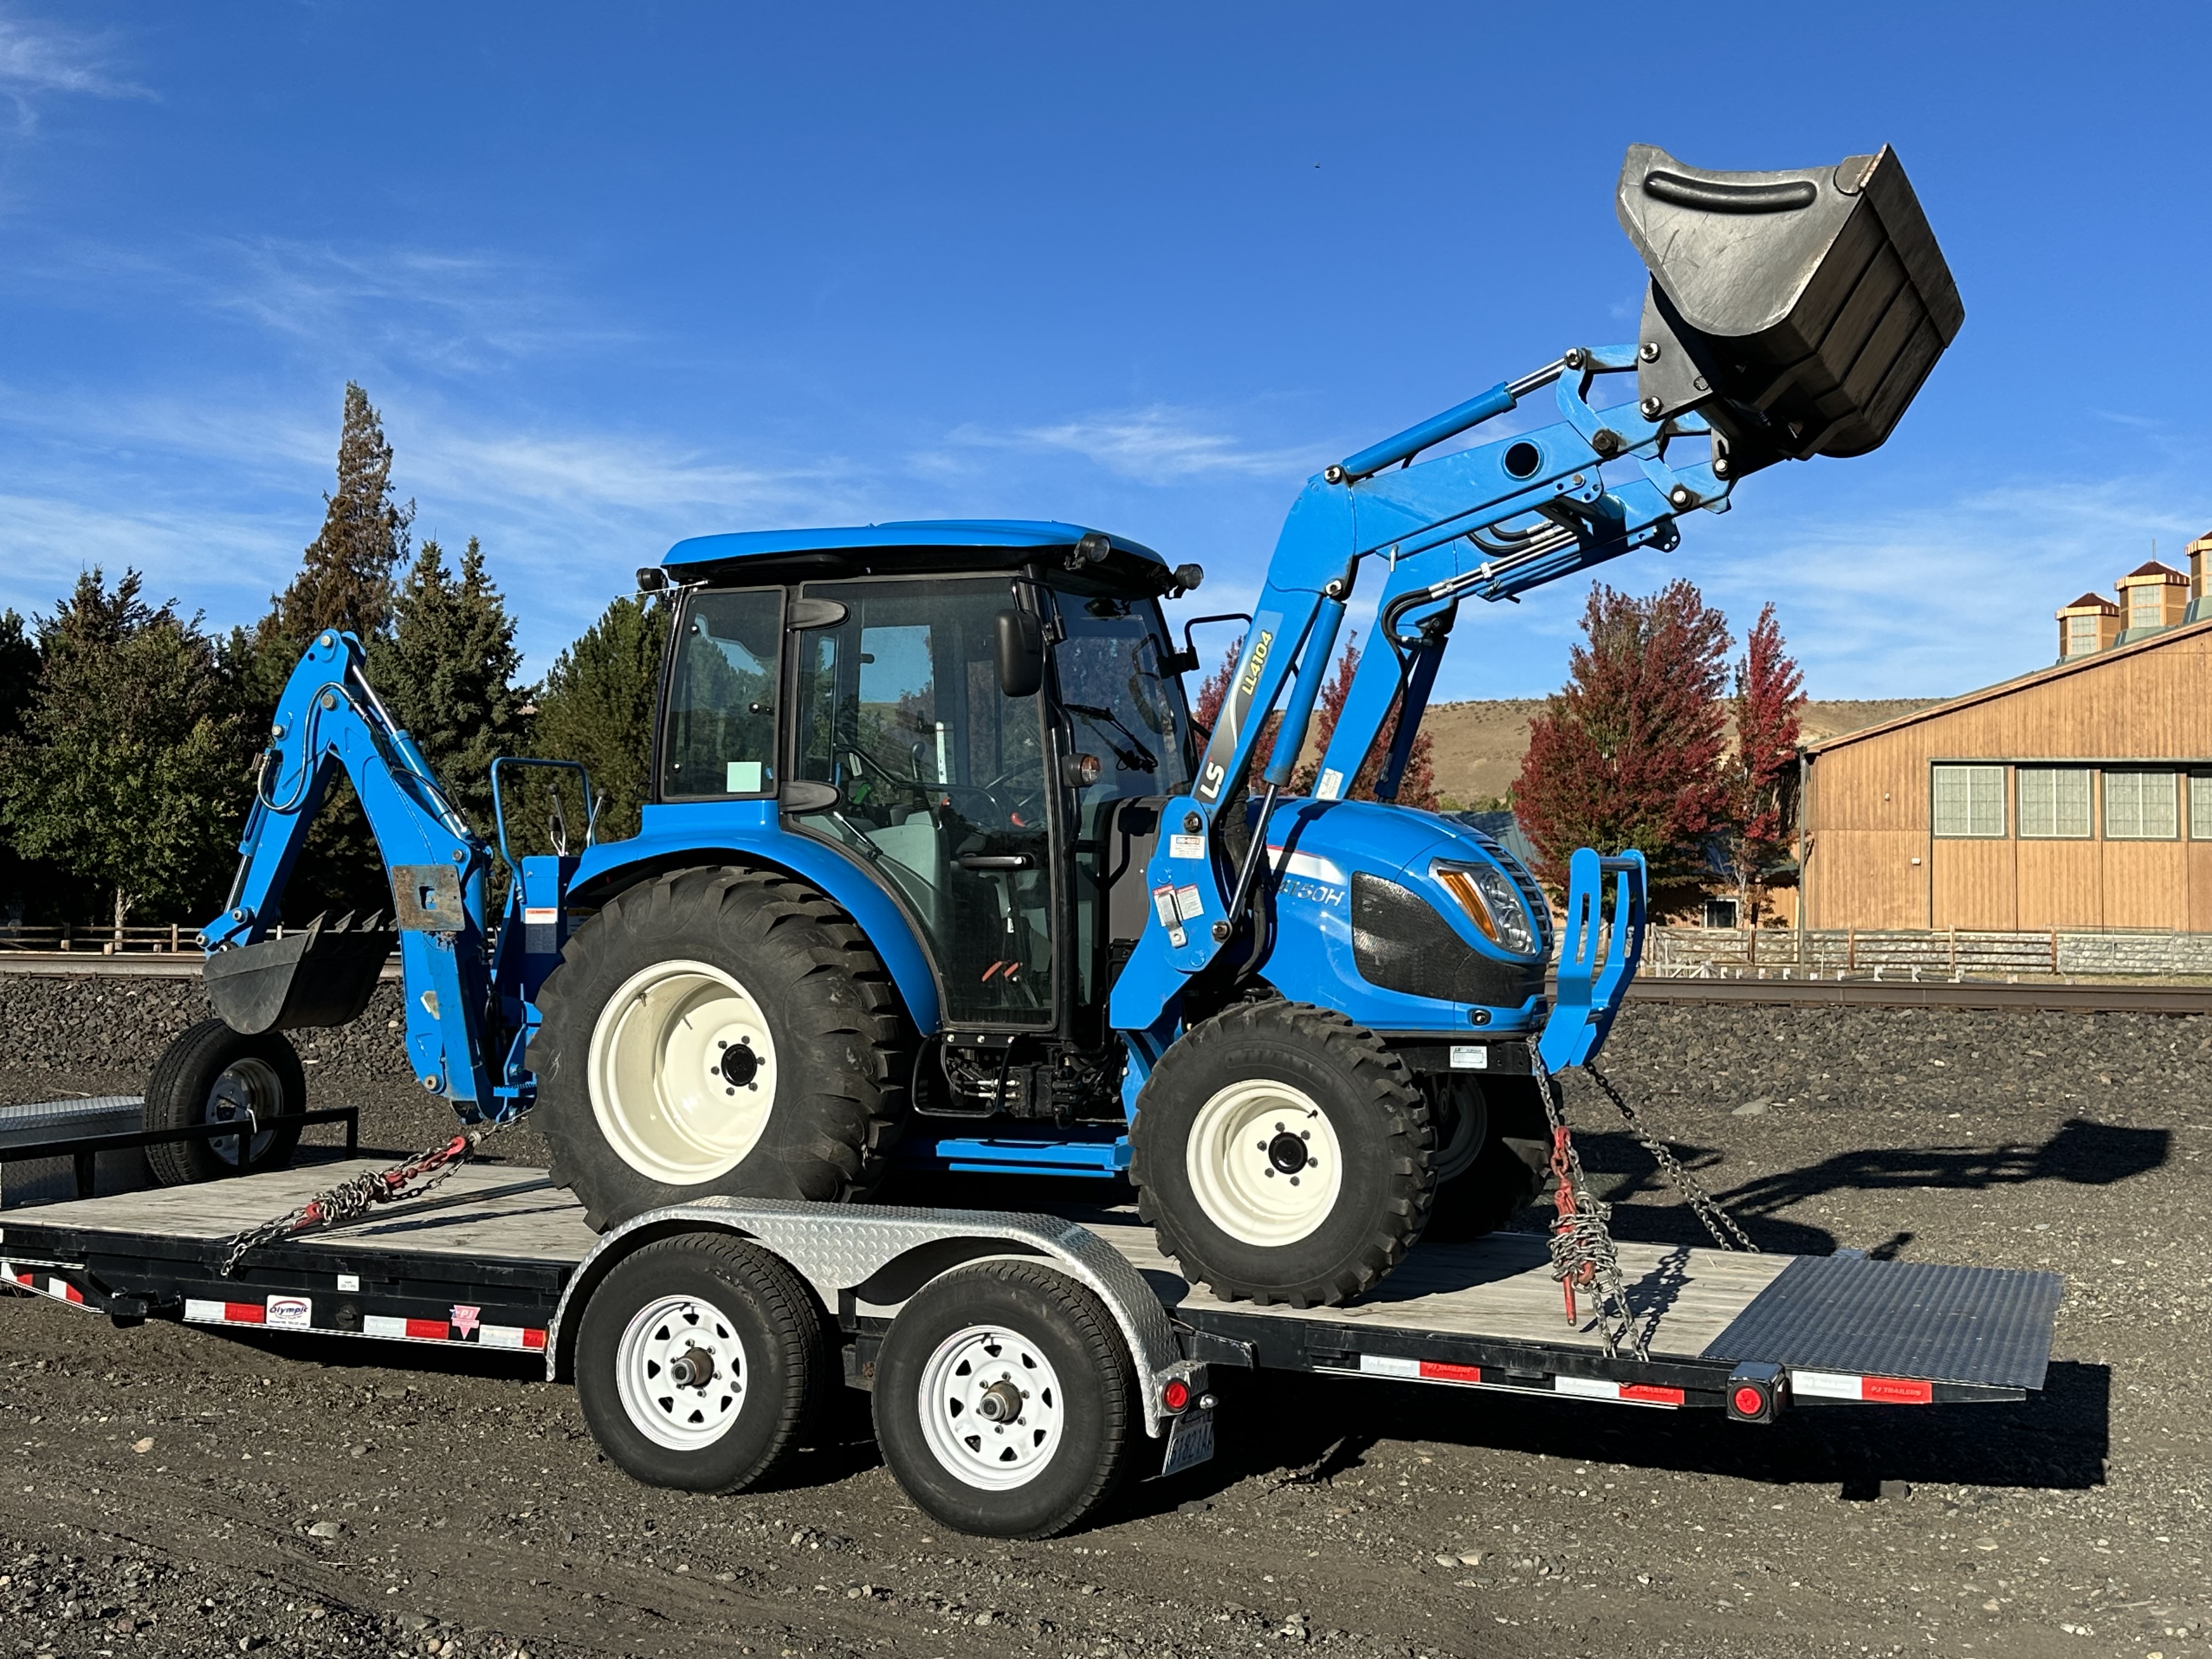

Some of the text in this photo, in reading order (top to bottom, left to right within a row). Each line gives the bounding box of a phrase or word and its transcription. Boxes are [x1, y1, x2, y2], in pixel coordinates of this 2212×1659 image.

[1240, 629, 1273, 696] LL4104
[1200, 761, 1224, 799] LS
[460, 1309, 475, 1318] PJ
